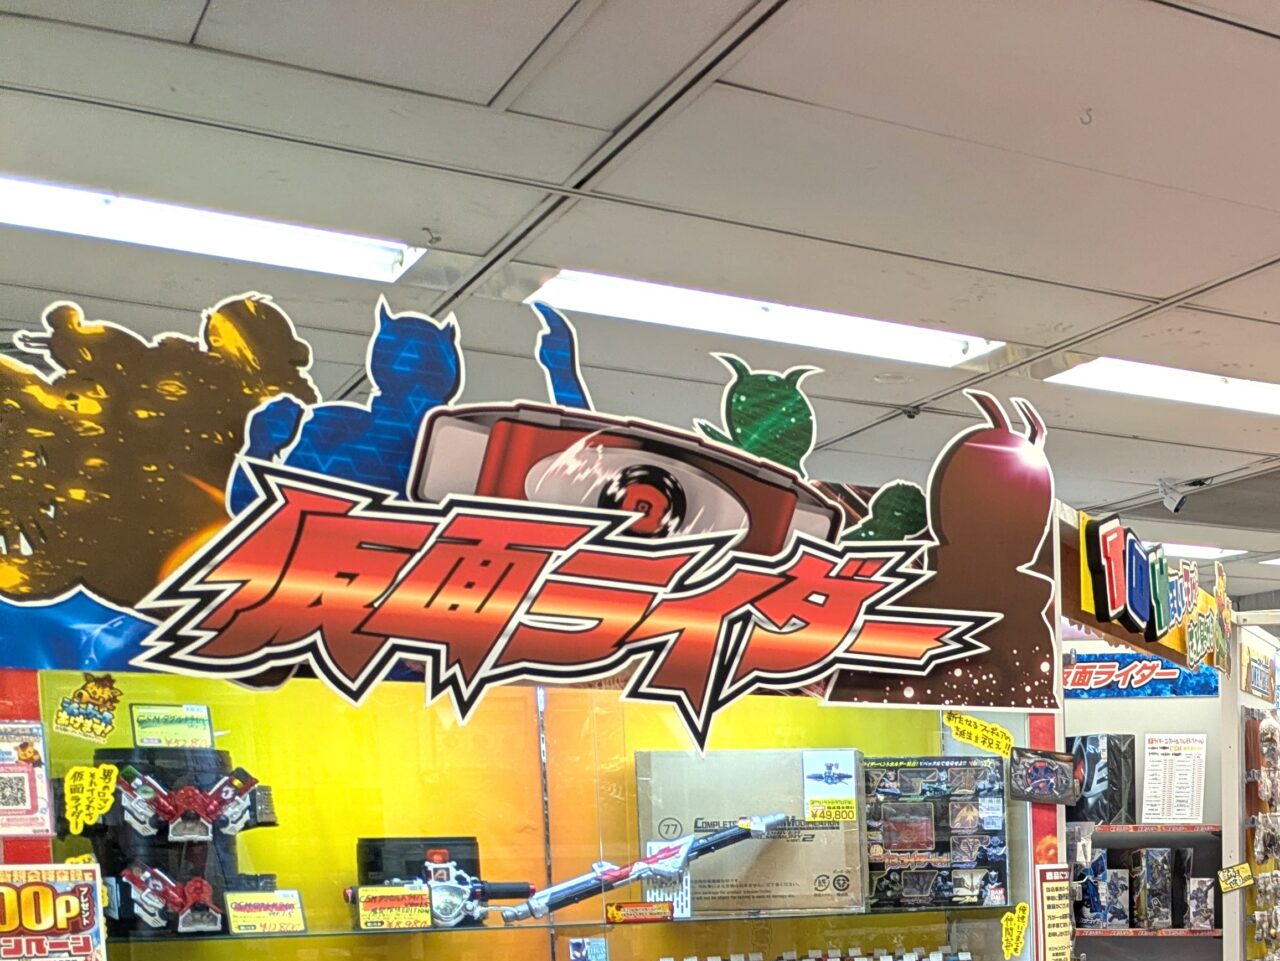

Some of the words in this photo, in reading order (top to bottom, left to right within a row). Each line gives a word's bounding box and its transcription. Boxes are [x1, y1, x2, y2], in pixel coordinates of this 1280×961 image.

[160, 472, 990, 735] 仮面ライダー
[1098, 517, 1169, 637] TOY
[663, 823, 677, 835] 77
[811, 810, 855, 822] ¥49,800
